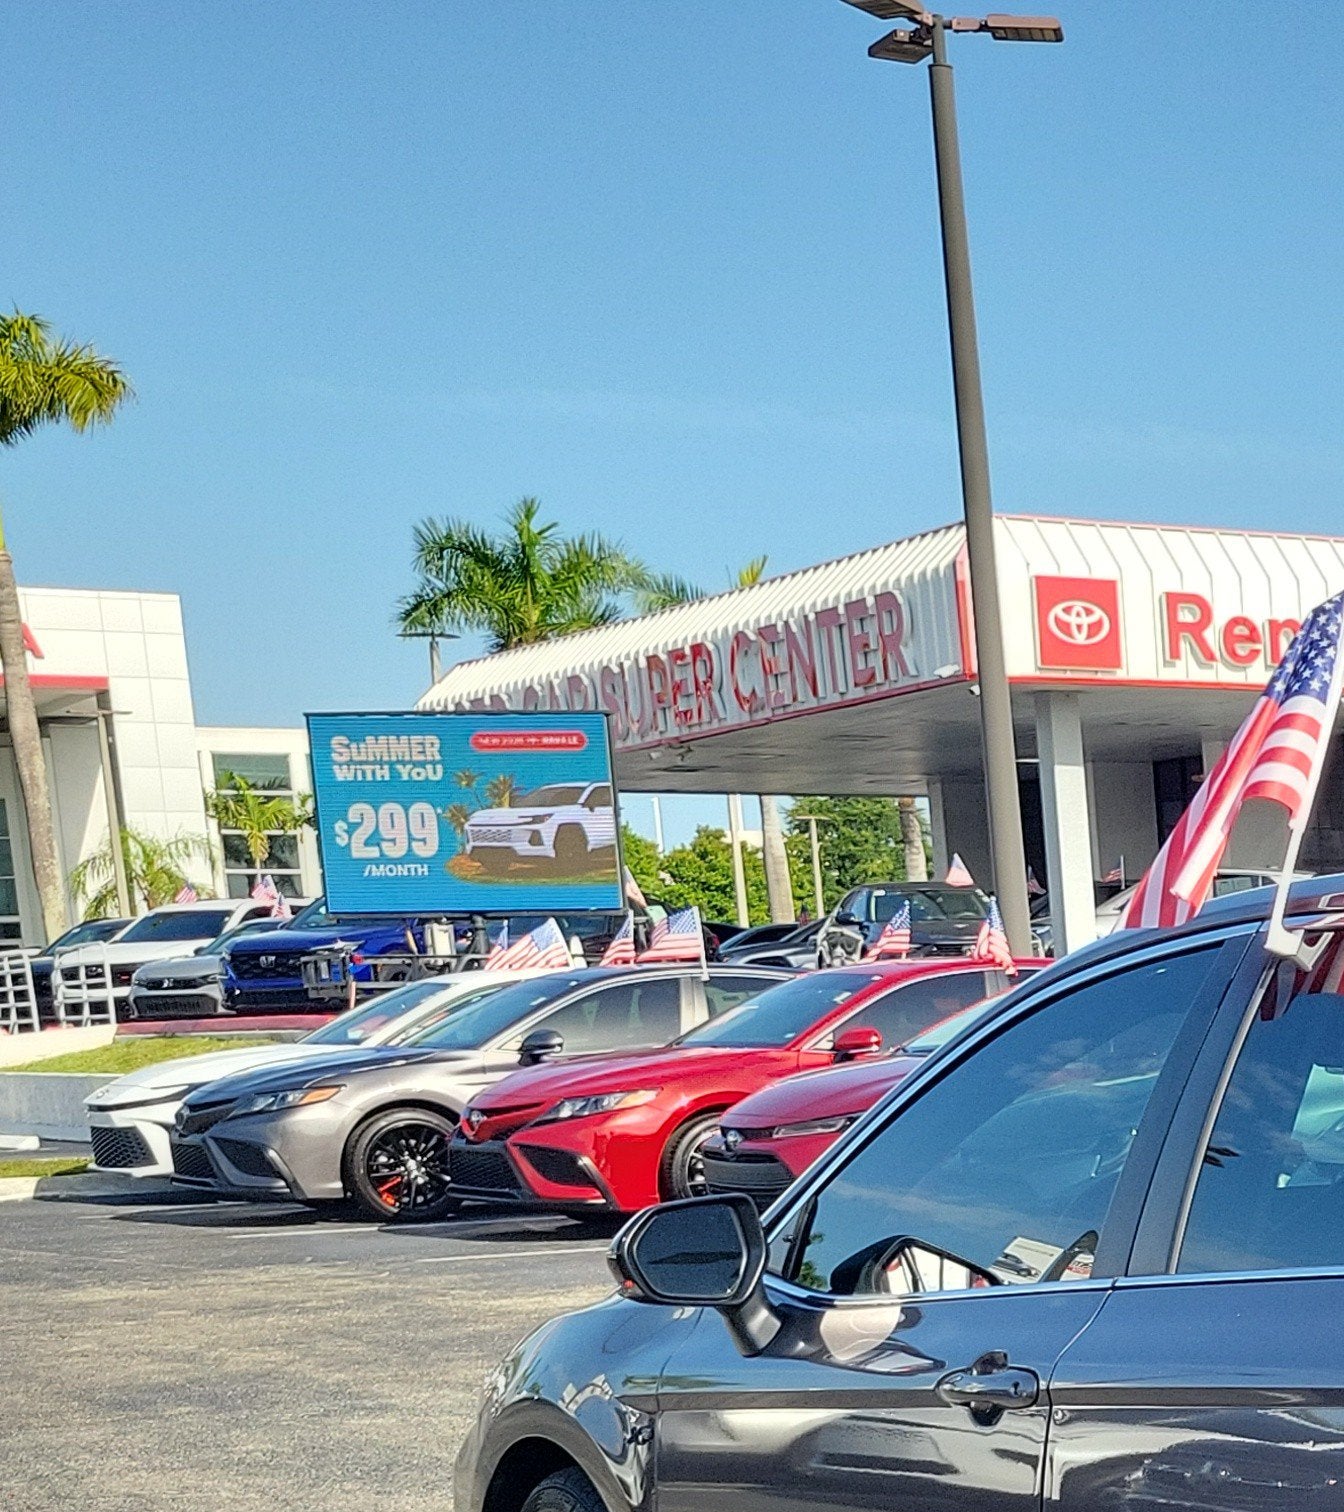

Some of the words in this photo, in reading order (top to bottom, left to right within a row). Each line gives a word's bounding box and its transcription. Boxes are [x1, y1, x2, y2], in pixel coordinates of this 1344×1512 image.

[601, 643, 724, 741] SUPER
[729, 590, 915, 713] CENTER
[363, 864, 429, 877] /MONTH
